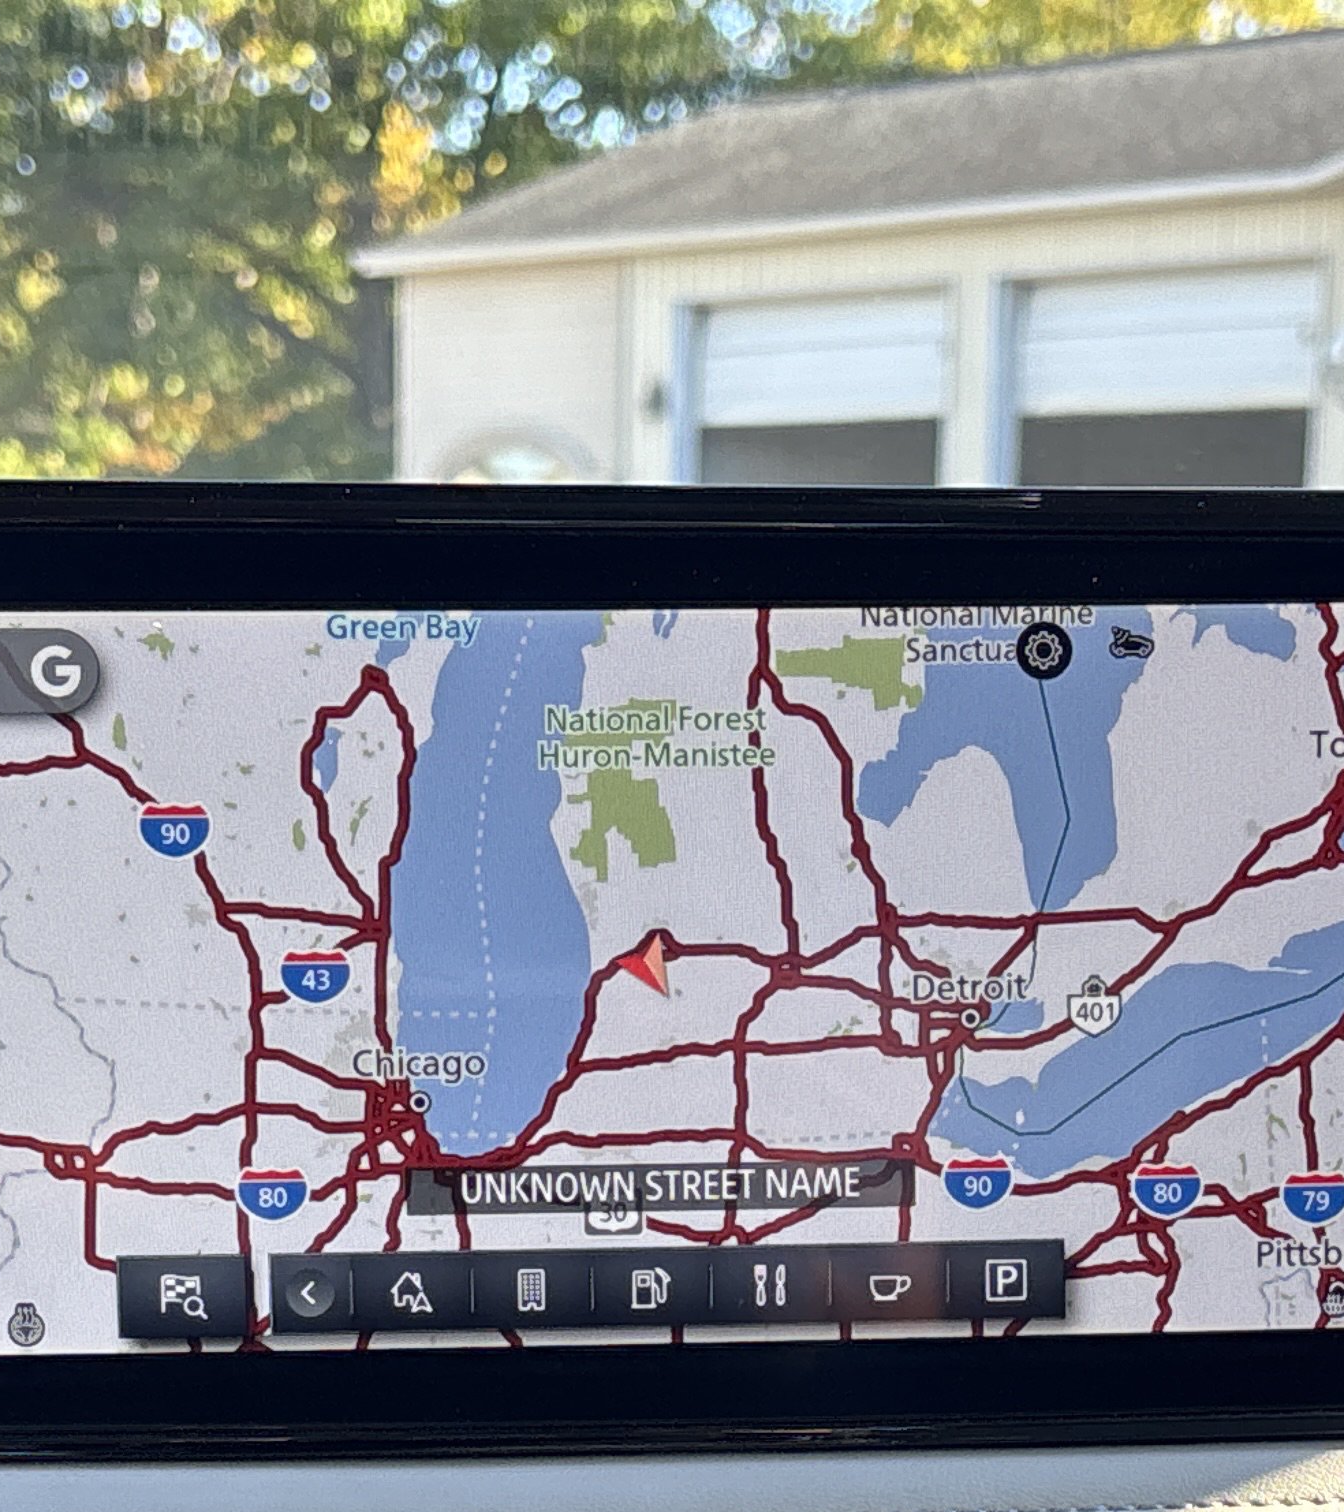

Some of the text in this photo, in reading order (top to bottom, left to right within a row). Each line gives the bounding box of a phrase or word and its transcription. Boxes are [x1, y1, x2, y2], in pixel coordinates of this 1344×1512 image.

[861, 605, 1094, 627] National Marine
[327, 614, 480, 647] Green Bay
[906, 637, 1018, 663] Sanctua
[30, 645, 82, 697] G
[546, 704, 767, 732] National Forest
[539, 741, 776, 768] Huron-Manistee
[161, 823, 190, 846] 90
[301, 969, 331, 991] 43
[912, 973, 1027, 1001] Detroit
[1075, 1002, 1116, 1023] 401
[353, 1048, 486, 1082] Chicago
[460, 1166, 861, 1204] UNKNOWN STREET NAME
[963, 1175, 993, 1197] 90
[1153, 1182, 1182, 1204] 80
[258, 1187, 288, 1208] 80
[1302, 1191, 1330, 1212] 79
[599, 1202, 628, 1223] 30
